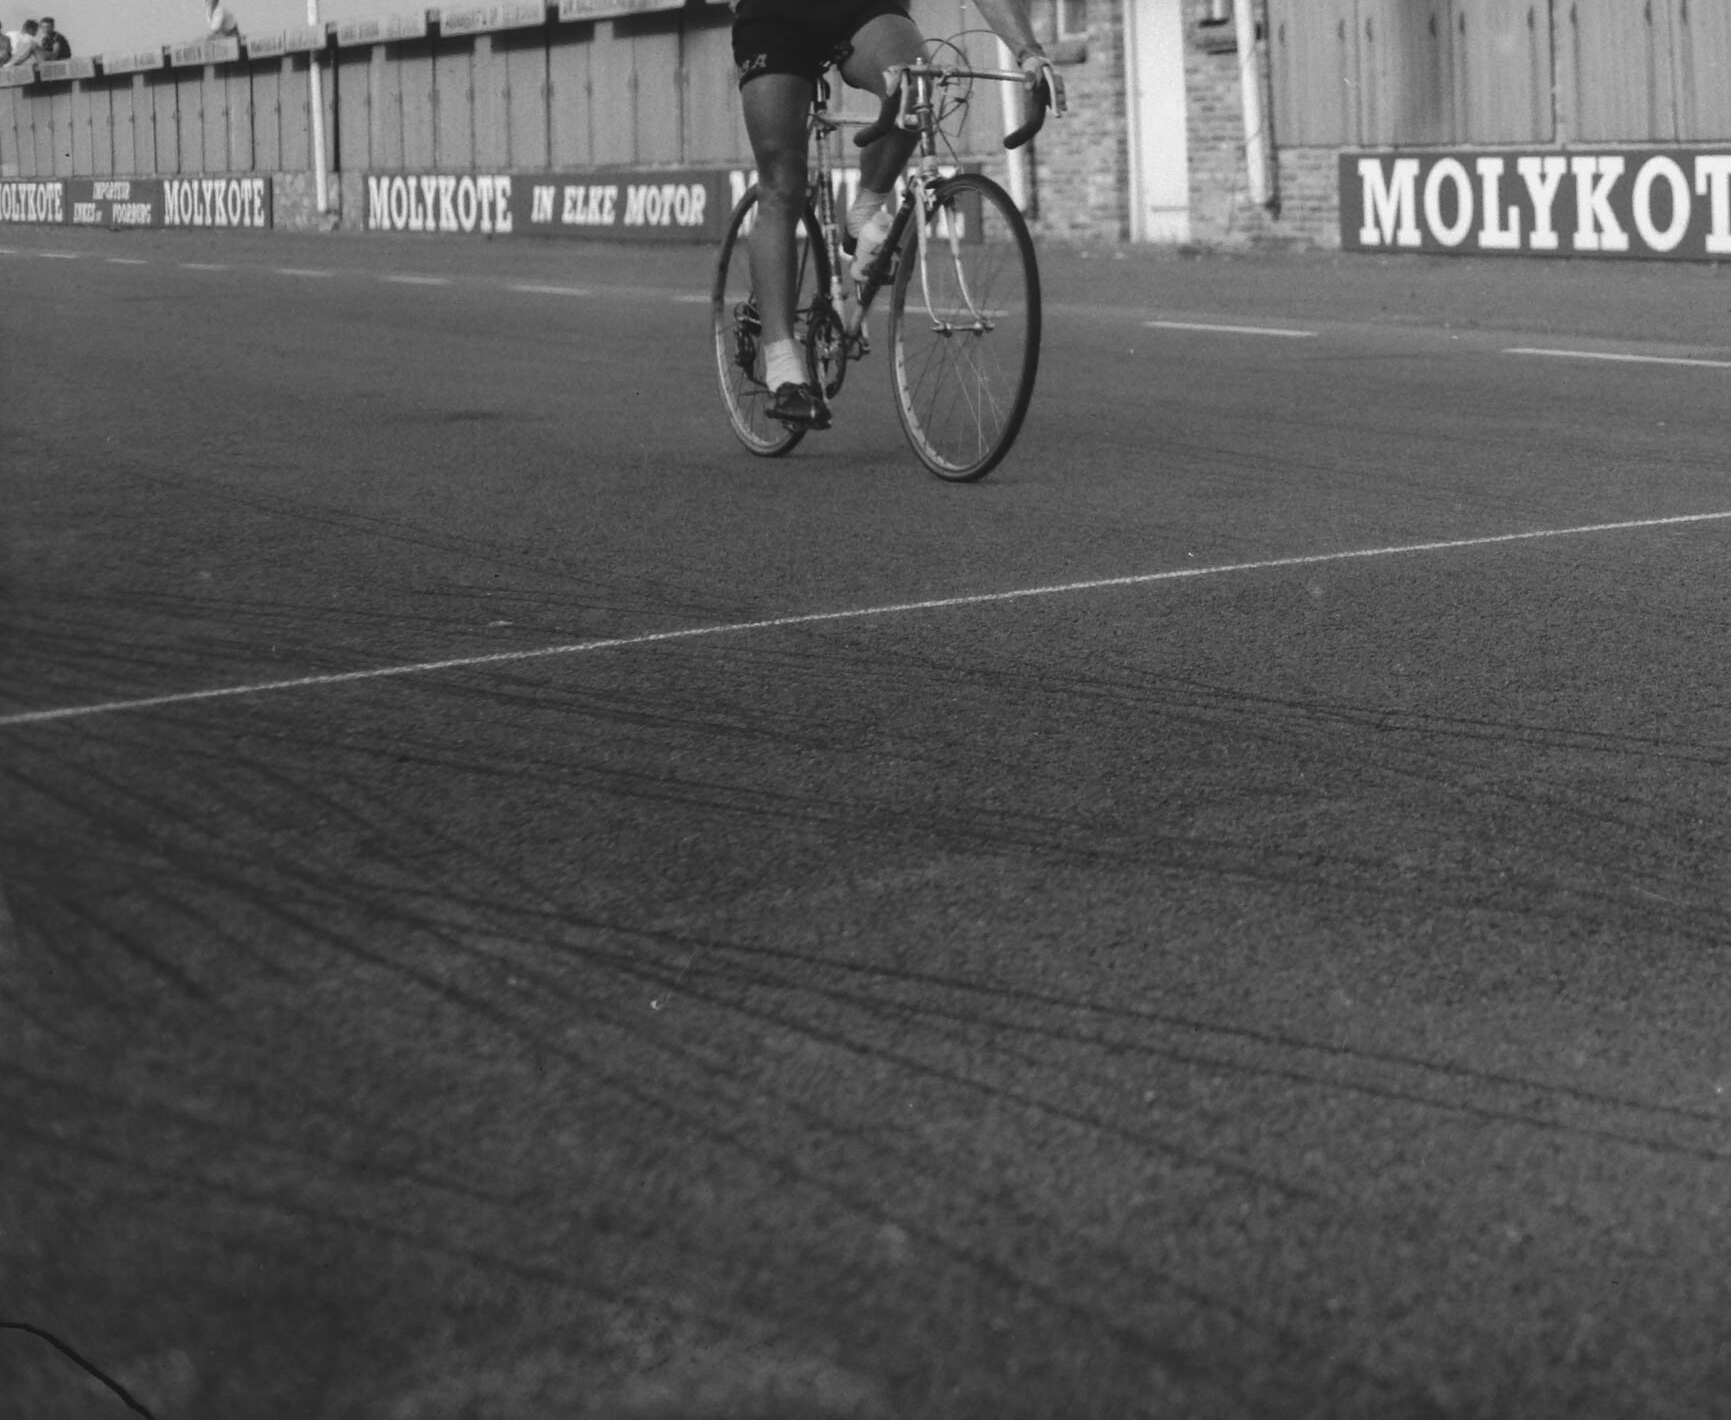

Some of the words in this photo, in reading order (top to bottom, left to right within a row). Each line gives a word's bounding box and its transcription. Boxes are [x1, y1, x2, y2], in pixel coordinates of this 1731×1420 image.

[0, 182, 63, 222] OLYKOTE
[163, 178, 264, 227] MOLYKOTE
[368, 175, 512, 233] MOLYKOTE
[532, 186, 555, 223] IN
[562, 186, 617, 225] ELKE
[624, 184, 707, 227] MOTOR
